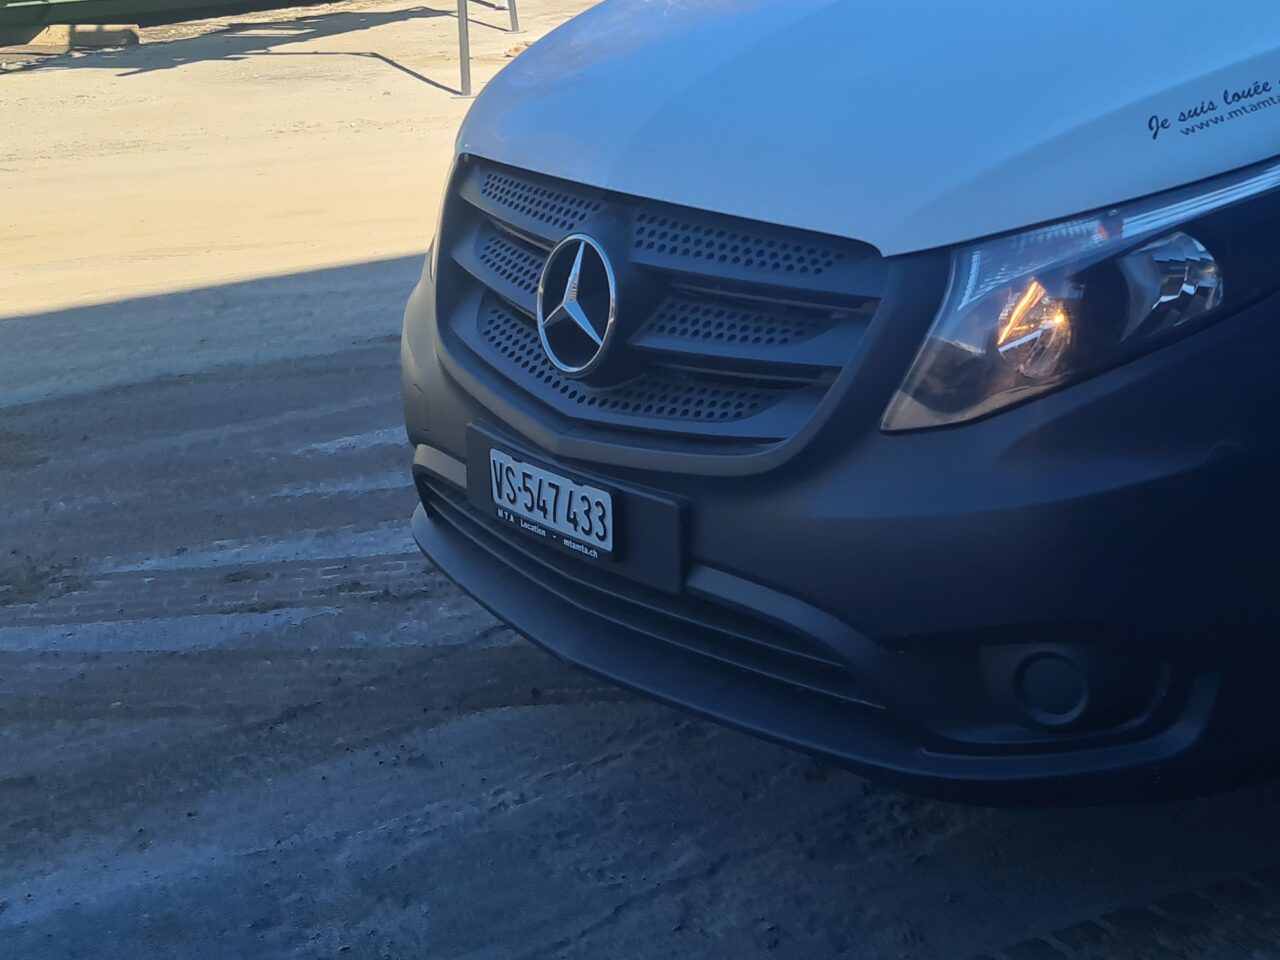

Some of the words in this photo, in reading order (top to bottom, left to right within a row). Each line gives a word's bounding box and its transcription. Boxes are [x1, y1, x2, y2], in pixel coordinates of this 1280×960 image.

[1148, 115, 1171, 140] Je
[1178, 101, 1217, 122] suis
[520, 519, 546, 537] Location
